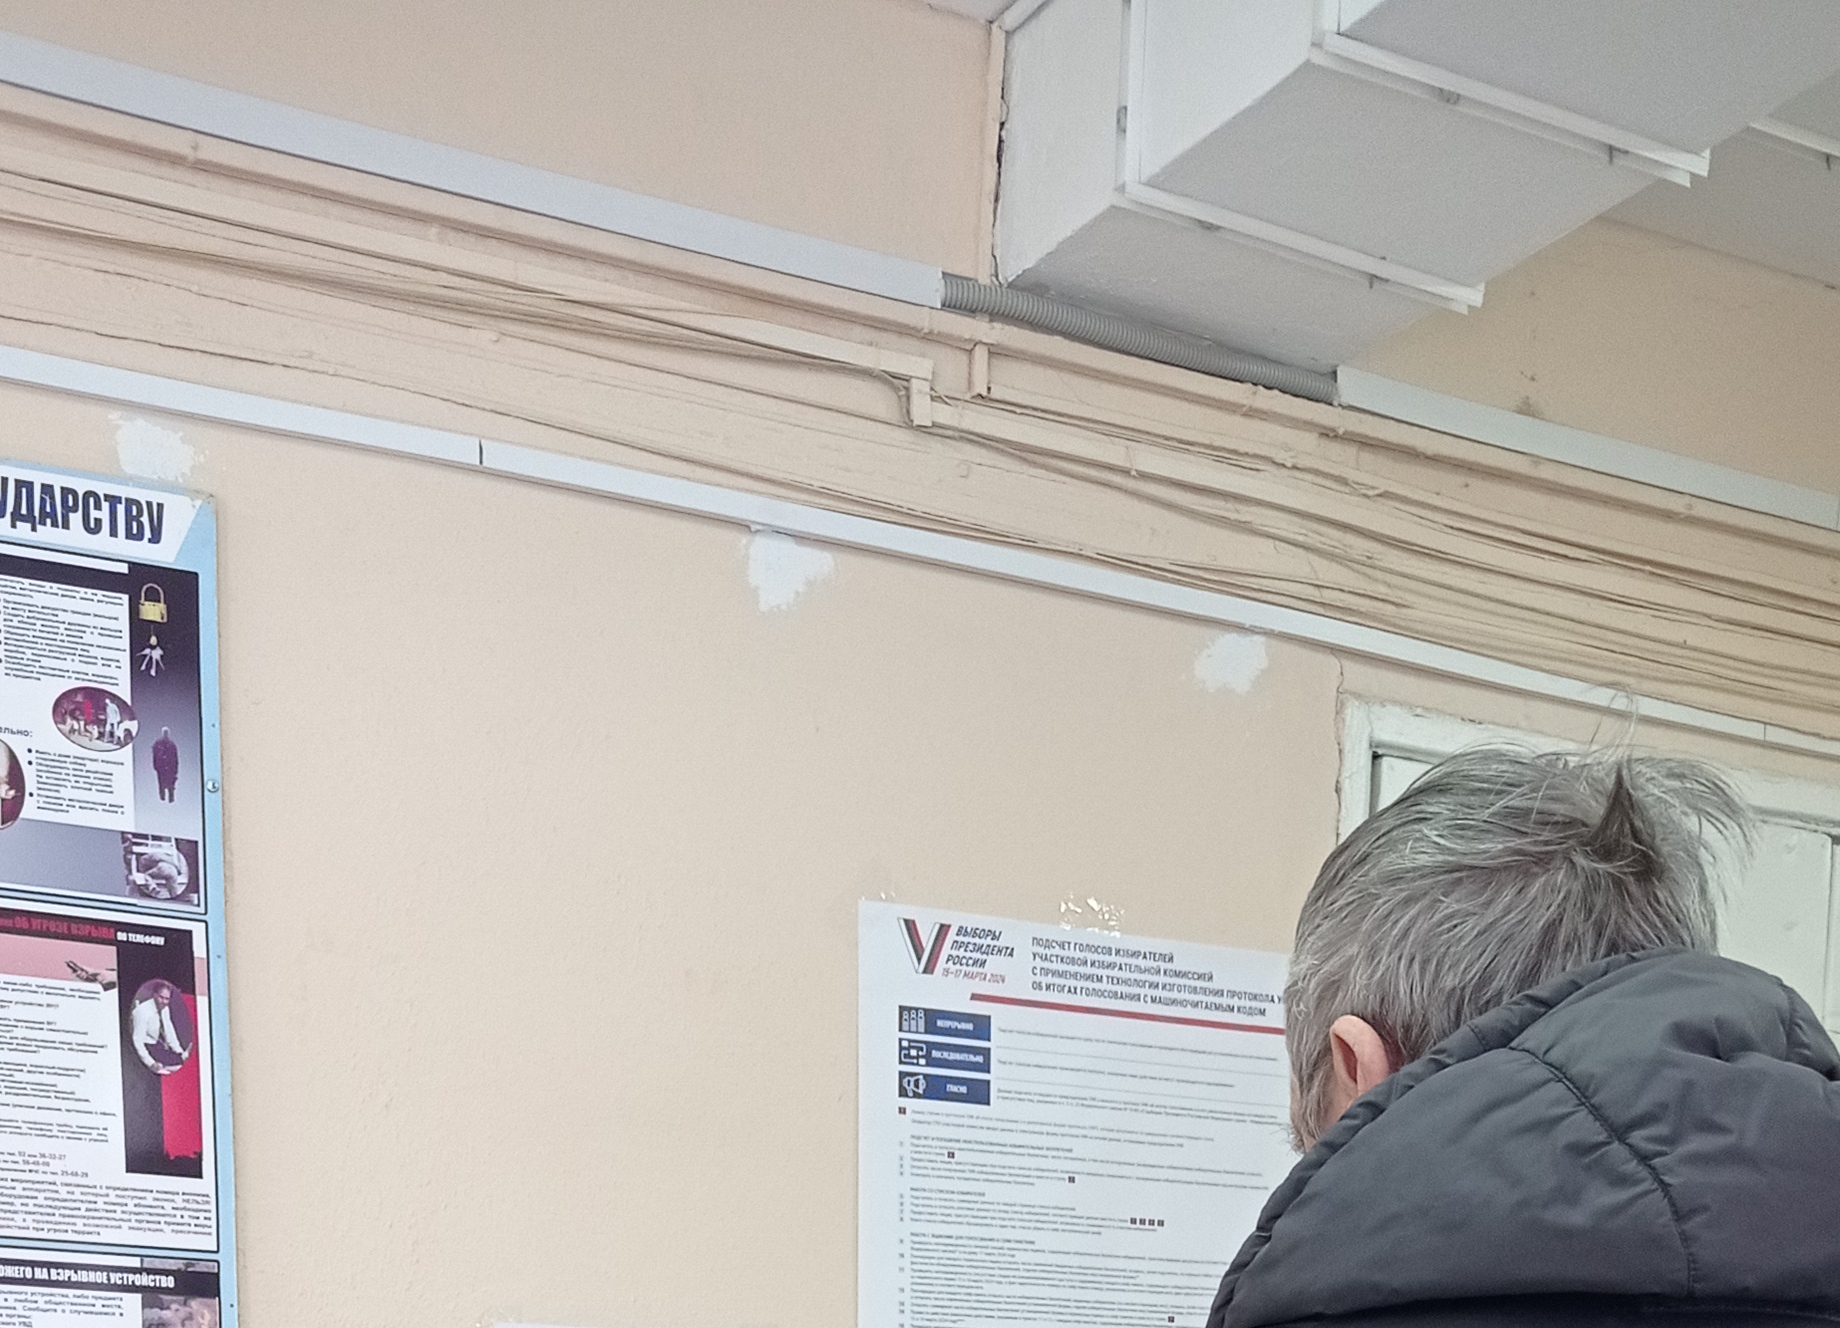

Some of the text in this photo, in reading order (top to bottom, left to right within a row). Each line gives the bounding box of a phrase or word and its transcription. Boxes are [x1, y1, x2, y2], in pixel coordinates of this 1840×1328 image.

[956, 925, 1003, 941] ВЫБОРЫ
[950, 940, 1015, 958] ПРЕЗИДЕНТА
[1032, 937, 1174, 963] ПОДСЧЕТ ГОЛОСОВ ИЗБИРАТЕЛЕЙ
[945, 954, 988, 969] РОССИИ
[1032, 952, 1214, 982] УЧАСТКОВОЙ ИЗБИРАТЕЛЬНОЙ КОМИССИЕЙ
[962, 970, 988, 982] МАРТА
[1031, 966, 1038, 976] С
[1039, 967, 1104, 983] ПРИМЕНЕНИЕМ
[1105, 974, 1160, 990] ТЕХНОЛОГИИ
[1161, 982, 1225, 998] ИЗГОТОВЛЕНИЯ
[1226, 989, 1276, 1004] ПРОТОКОЛА
[1031, 981, 1267, 1017] ОБ ИТОГАХ ГОЛОСОВАНИЯ С МАШИНОЧИТАЕМЫМ КОДОМ
[34, 1266, 49, 1280] НА
[50, 1267, 109, 1284] ВЗРЫВНОЕ
[110, 1271, 176, 1289] УСТРОЙСТВО
